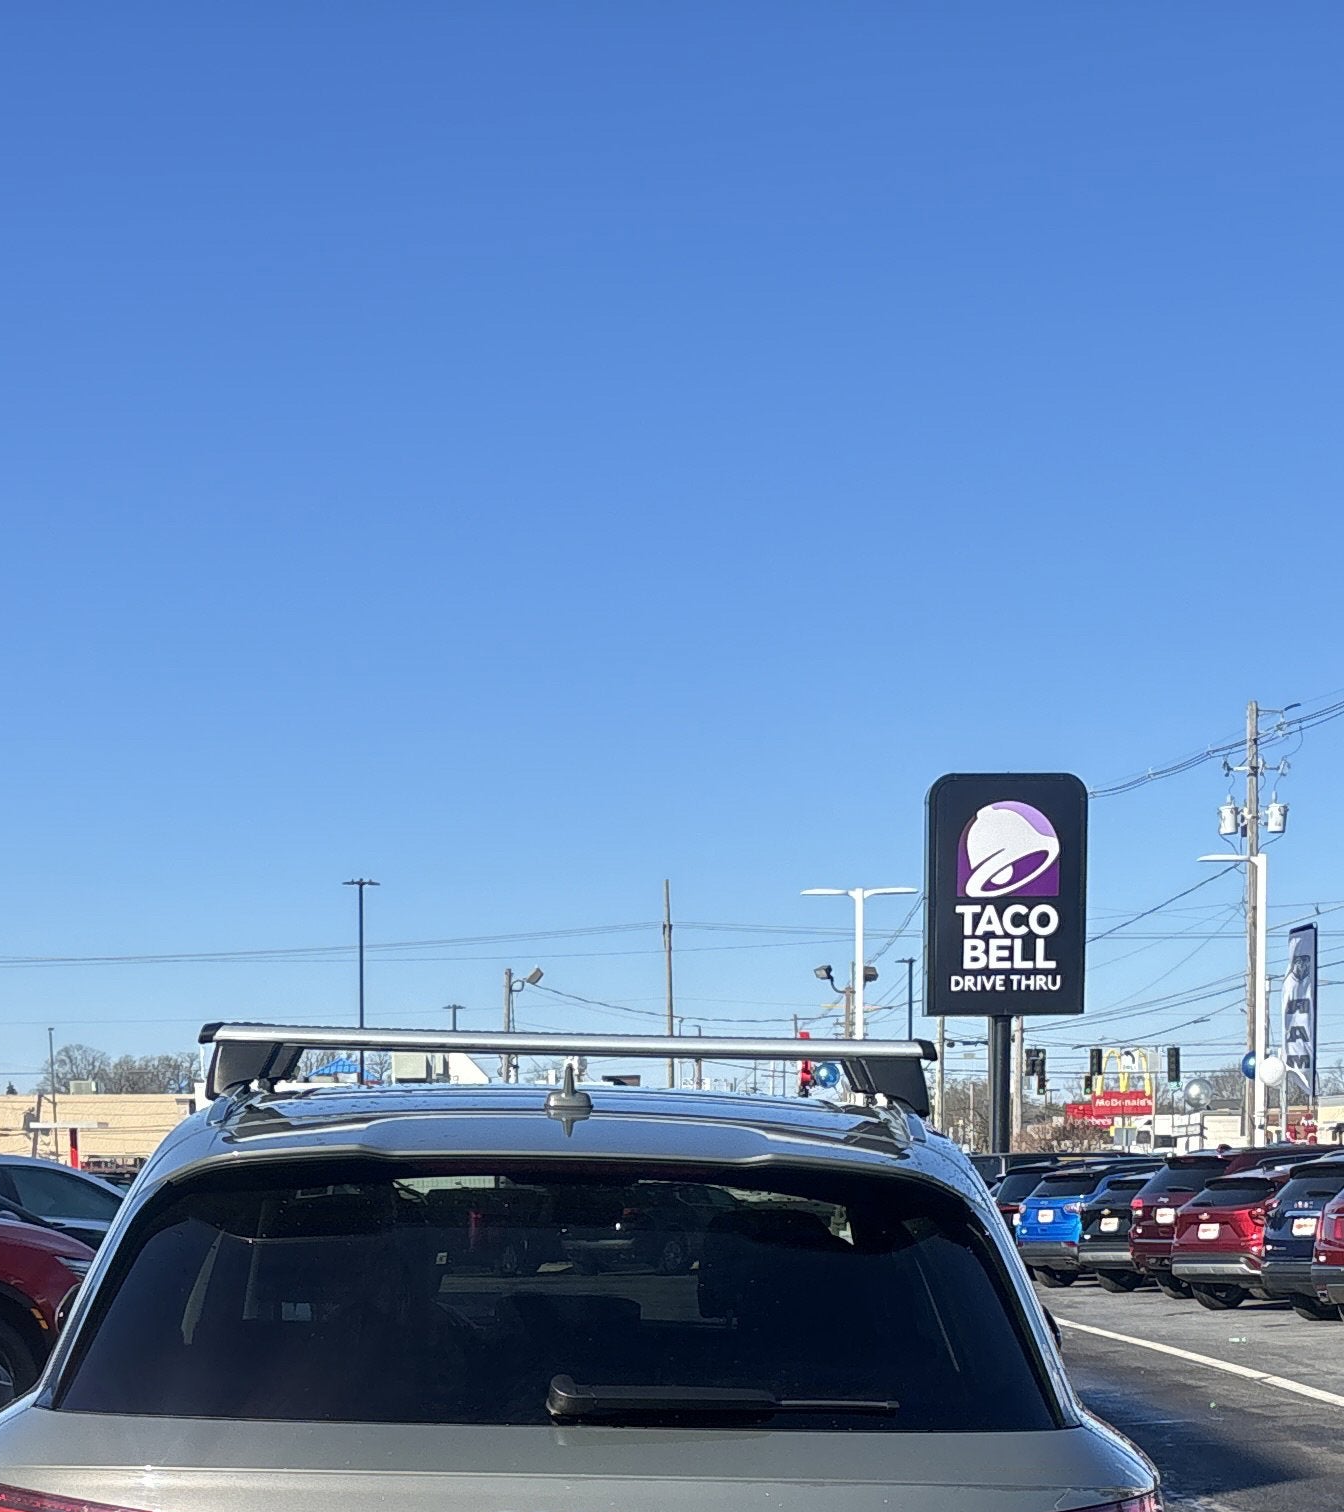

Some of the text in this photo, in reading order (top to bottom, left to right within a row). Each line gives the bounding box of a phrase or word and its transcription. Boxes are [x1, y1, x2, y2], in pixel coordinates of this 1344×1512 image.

[955, 904, 1059, 936] TACO
[963, 938, 1057, 970] BELL
[950, 974, 1062, 992] DRIVE THRU
